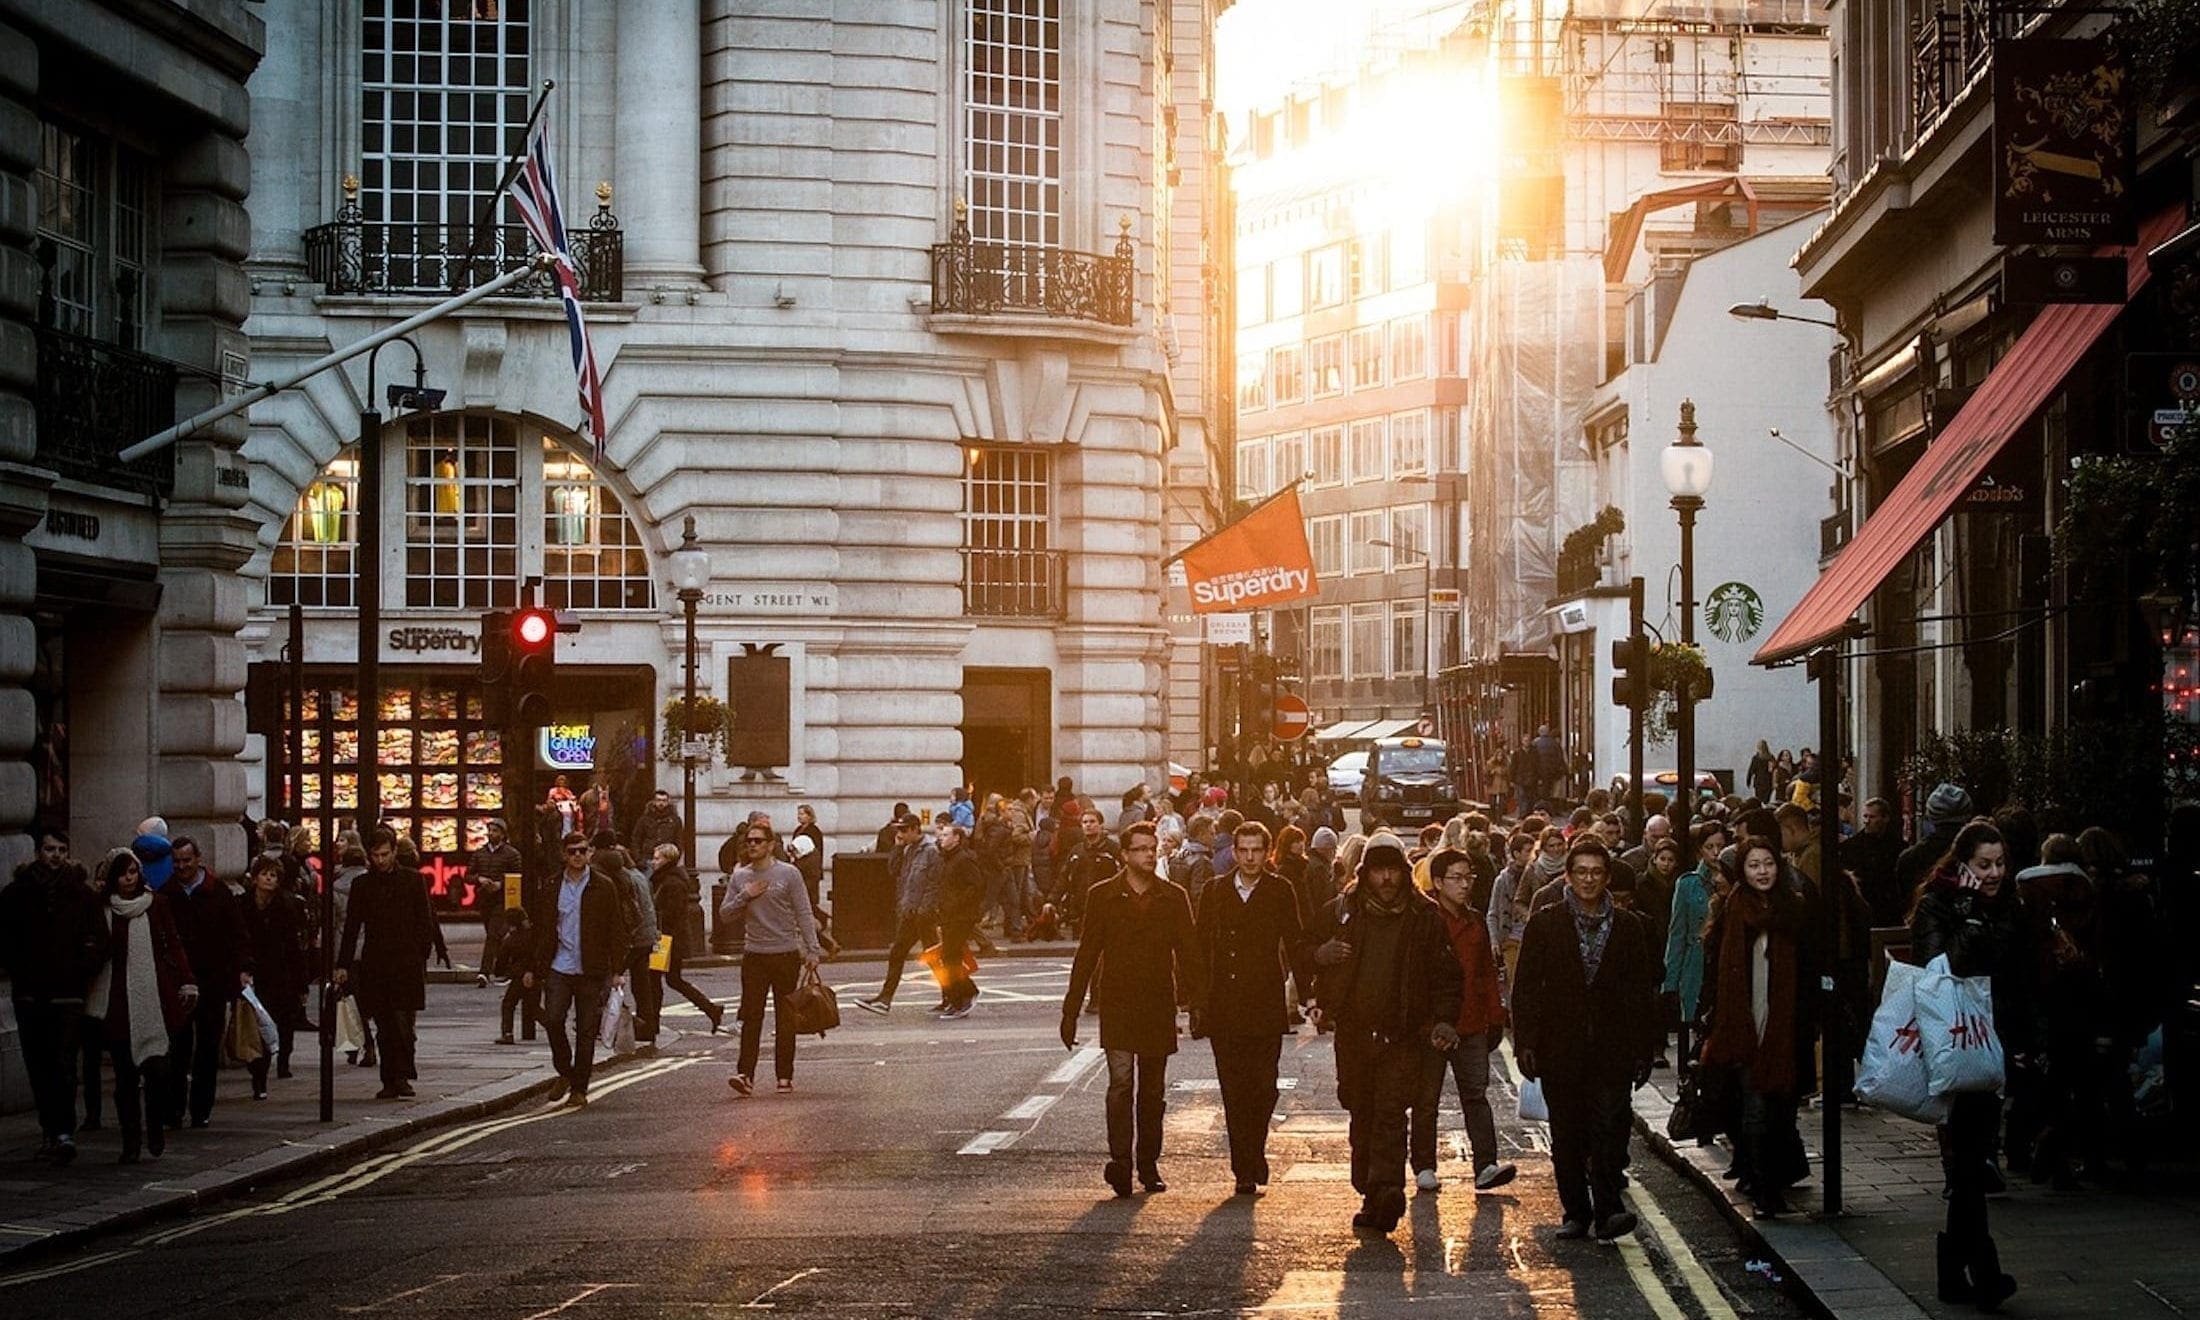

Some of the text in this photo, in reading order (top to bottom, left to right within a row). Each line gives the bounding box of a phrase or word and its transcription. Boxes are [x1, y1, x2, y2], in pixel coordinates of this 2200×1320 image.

[2023, 211, 2112, 225] LEICESTER
[2045, 227, 2092, 239] ARMS
[1194, 567, 1309, 605] Superdry
[701, 594, 742, 606] GENT
[753, 594, 803, 607] STREET
[389, 628, 482, 655] Superdry
[1948, 1011, 1993, 1053] H&M
